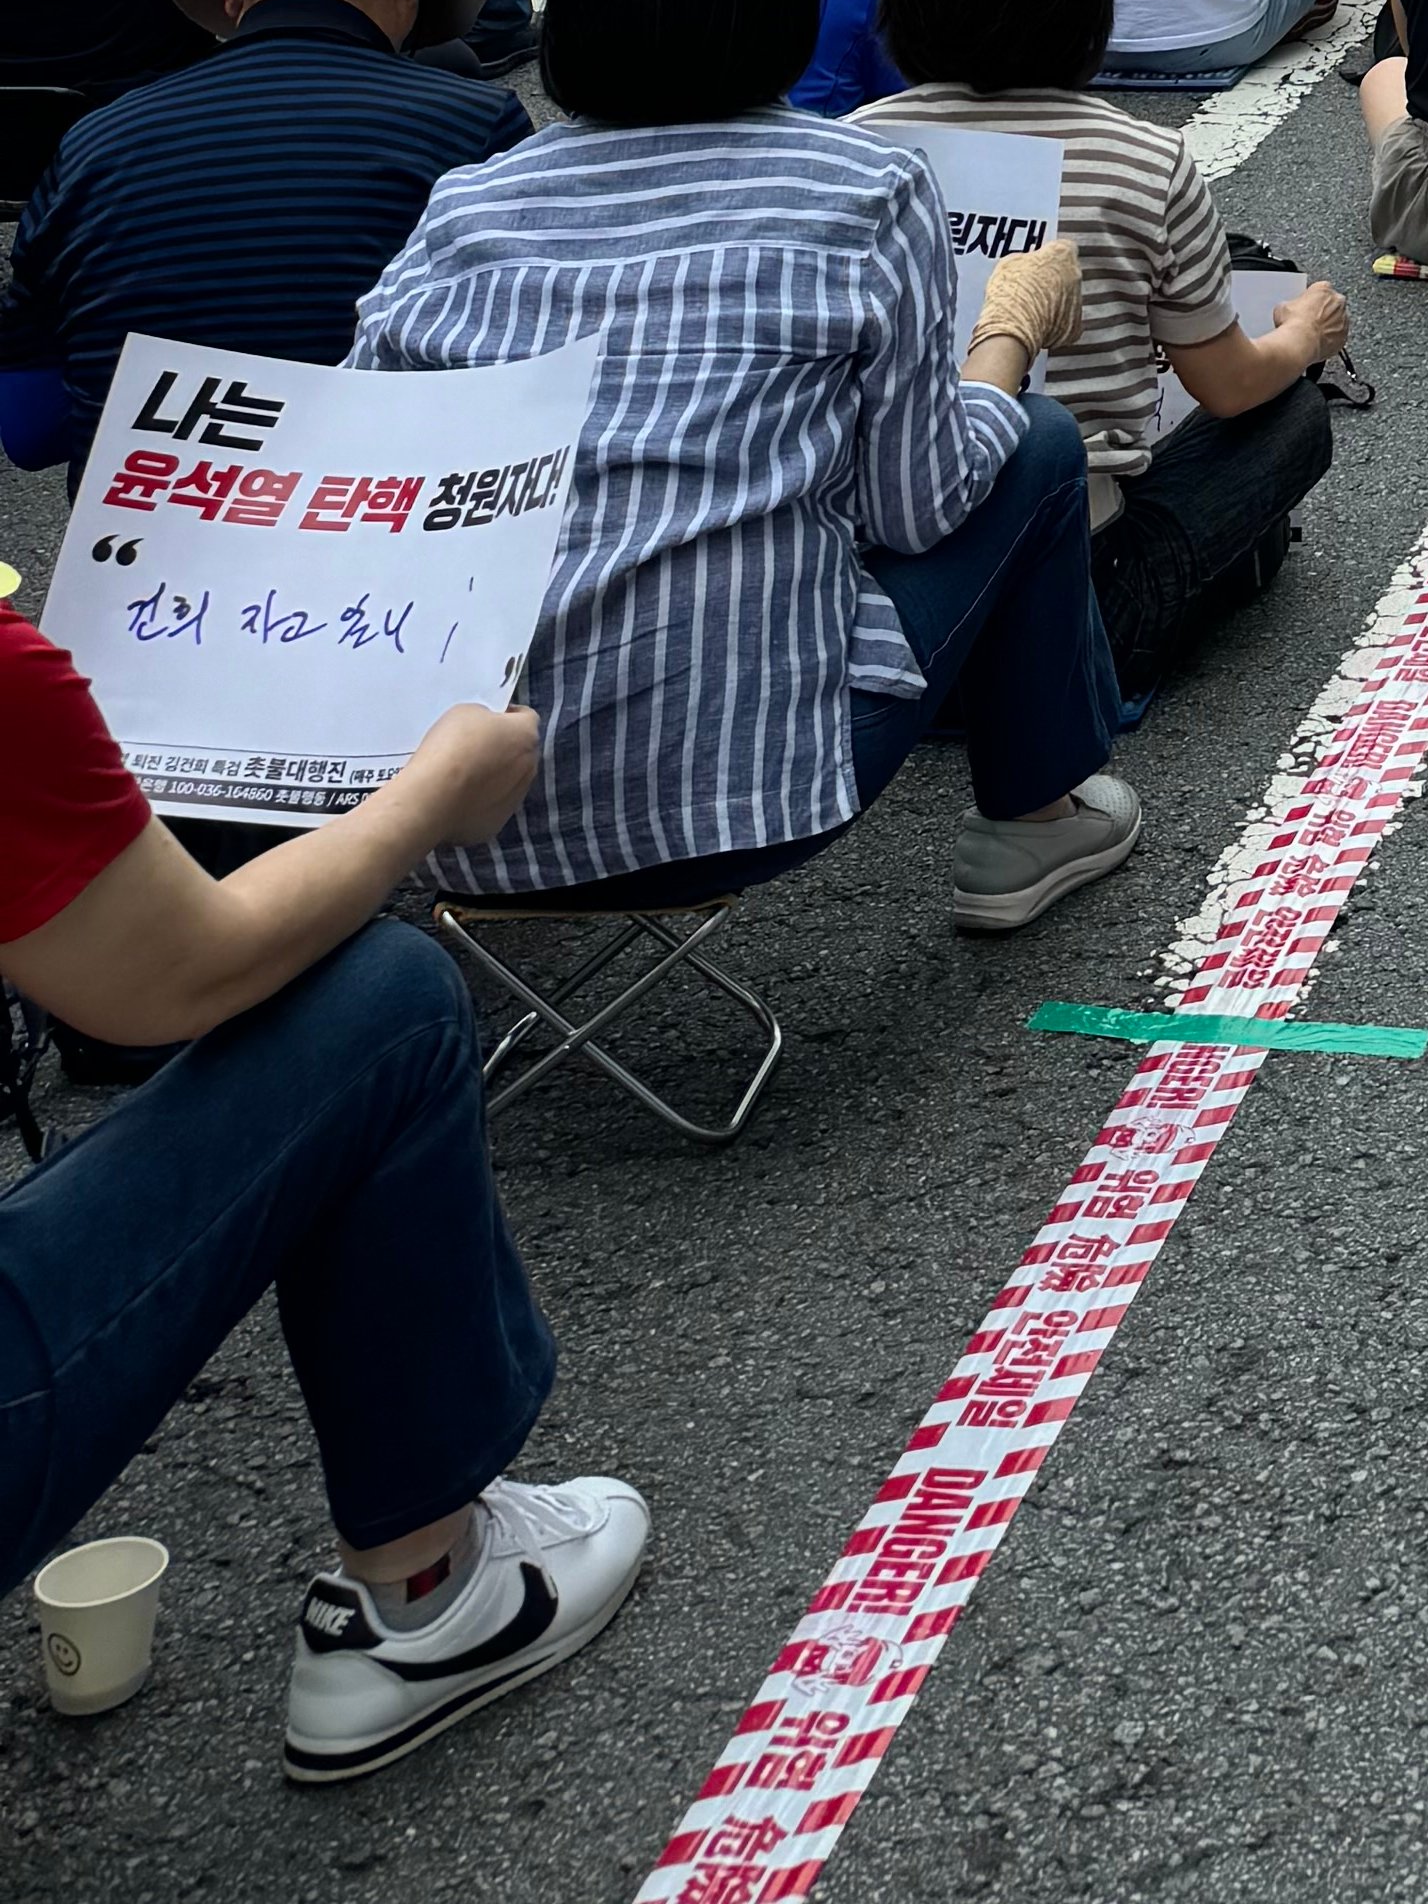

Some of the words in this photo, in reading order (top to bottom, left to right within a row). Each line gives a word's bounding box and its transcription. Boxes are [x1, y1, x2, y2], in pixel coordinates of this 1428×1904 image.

[132, 370, 286, 452] 나는
[102, 449, 303, 527] 윤석열
[299, 474, 427, 533] 탄핵
[422, 446, 571, 532] 청원자다!
[131, 752, 162, 772] 퇴진
[164, 755, 207, 775] 김건희
[211, 758, 241, 777] 특검
[244, 755, 348, 785] 촛불대행진
[1341, 699, 1418, 771] DANGER!
[1146, 1043, 1231, 1110] NGER!
[1080, 1166, 1158, 1221] 위험
[956, 1308, 1079, 1431] 안전제일
[864, 1466, 988, 1616] DANGER!
[305, 1595, 356, 1639] NIKE
[745, 1709, 850, 1792] 위험
